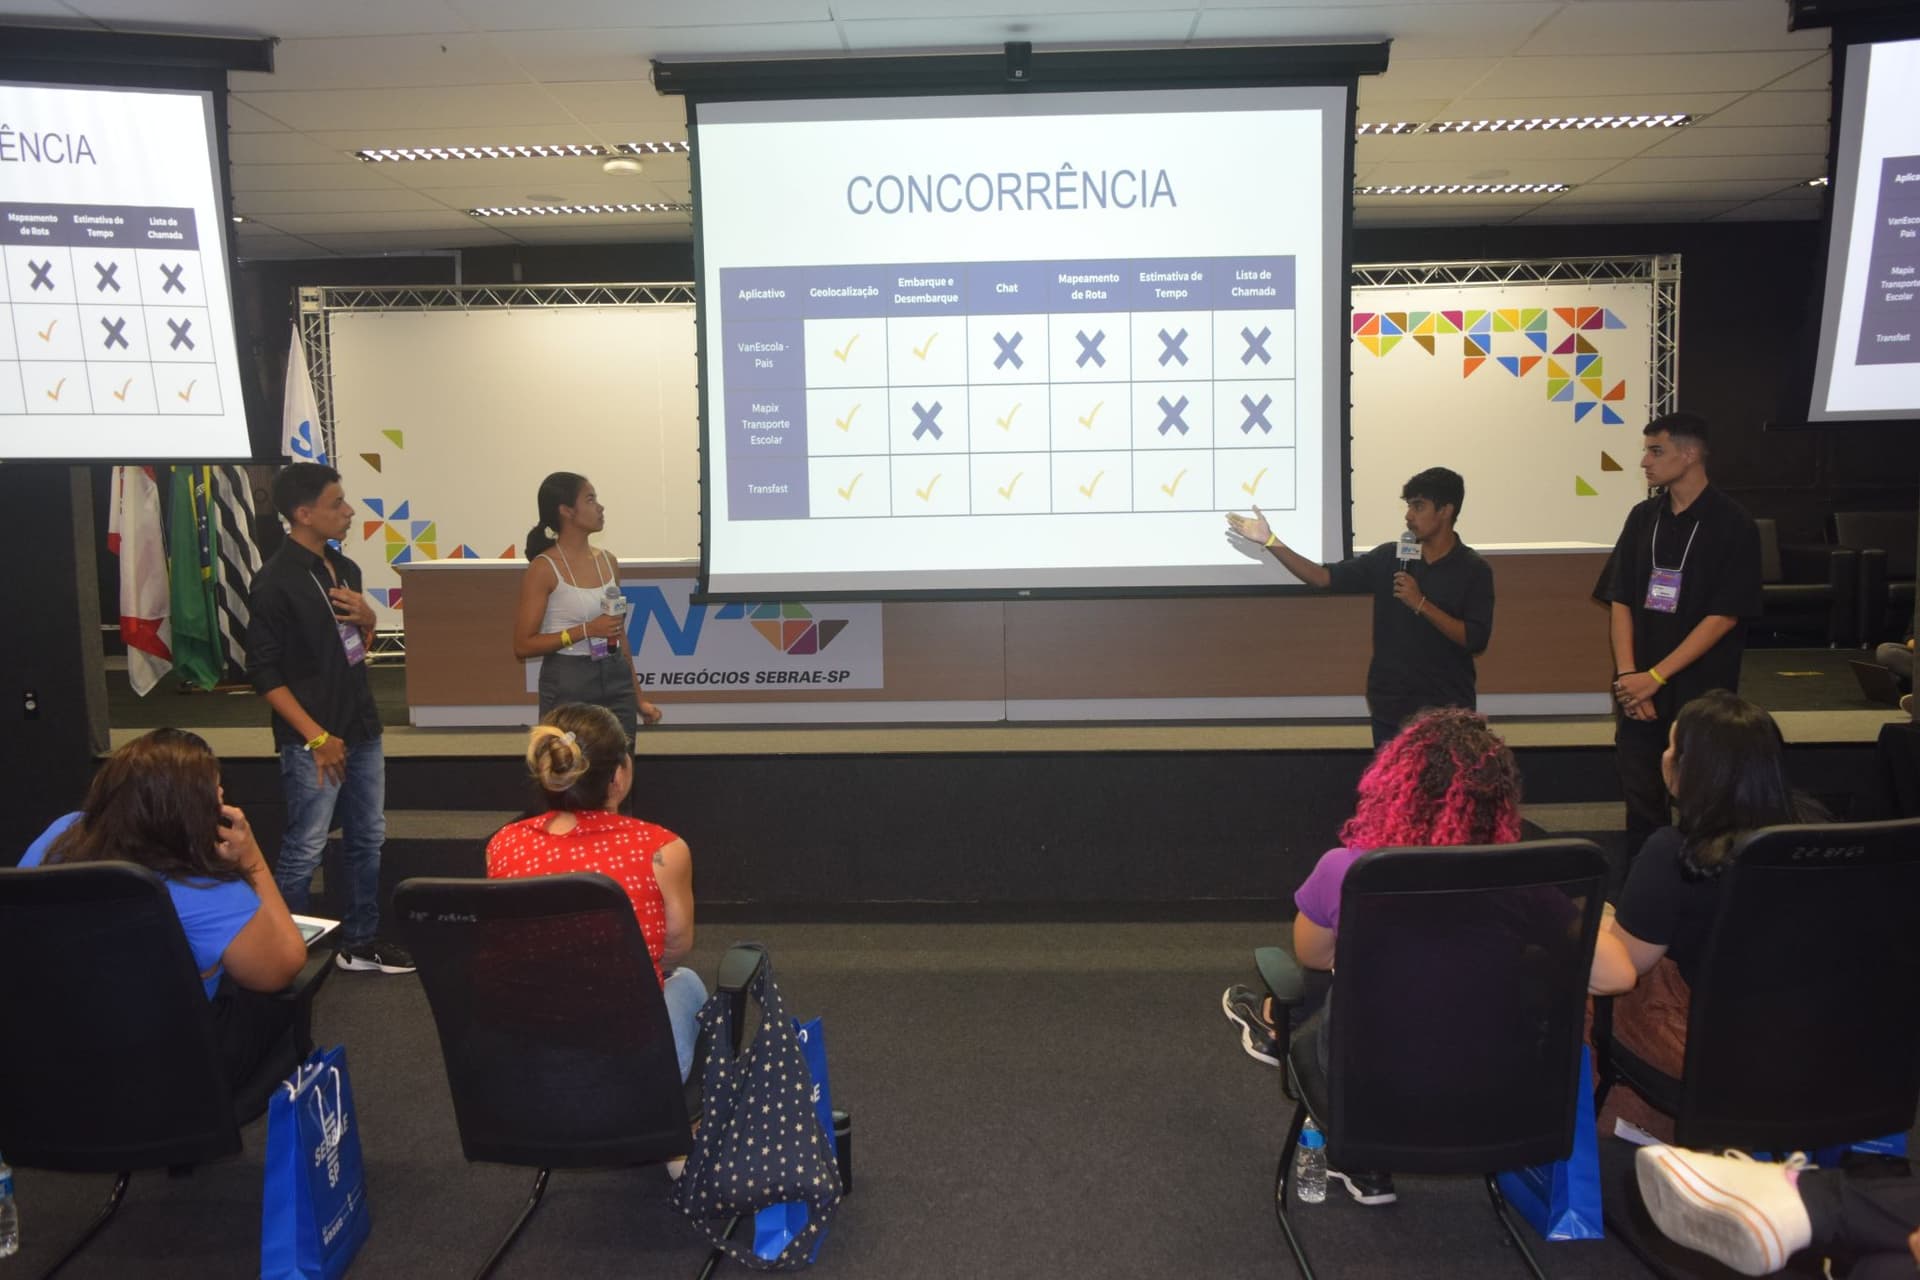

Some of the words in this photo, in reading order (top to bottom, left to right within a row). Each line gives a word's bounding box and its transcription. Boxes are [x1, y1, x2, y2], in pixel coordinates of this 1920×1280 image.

[847, 162, 1177, 215] CONCORRÊNCIA
[8, 213, 58, 223] Mapeamento
[73, 214, 112, 225] Estimativa
[114, 215, 124, 225] de
[149, 217, 168, 226] Lista
[169, 217, 178, 227] de
[20, 227, 30, 236] de
[31, 227, 50, 236] Rota
[87, 229, 114, 239] Tempo
[147, 231, 183, 240] Chamada
[1058, 273, 1120, 285] Mapeamento
[1139, 270, 1189, 282] Estimativa
[1191, 271, 1203, 281] de
[1236, 269, 1258, 280] Lista
[1260, 270, 1272, 279] de
[898, 277, 947, 289] Embarque
[948, 277, 954, 287] e
[996, 283, 1018, 293] Chat
[738, 287, 786, 301] Aplicativo
[809, 286, 879, 299] Geolocalização
[1071, 290, 1084, 300] de
[1085, 289, 1107, 299] Rota
[1155, 288, 1188, 299] Tempo
[1231, 287, 1276, 297] Chamada
[894, 293, 959, 305] Desembarque
[737, 342, 784, 352] VanEscola
[752, 403, 779, 414] Mapix
[742, 420, 790, 430] Transporte
[750, 435, 783, 445] Escolar
[748, 484, 789, 494] Transfast
[620, 586, 709, 656] N
[660, 668, 750, 685] NEGÓCIOS
[755, 670, 850, 684] SEBRAE-SP
